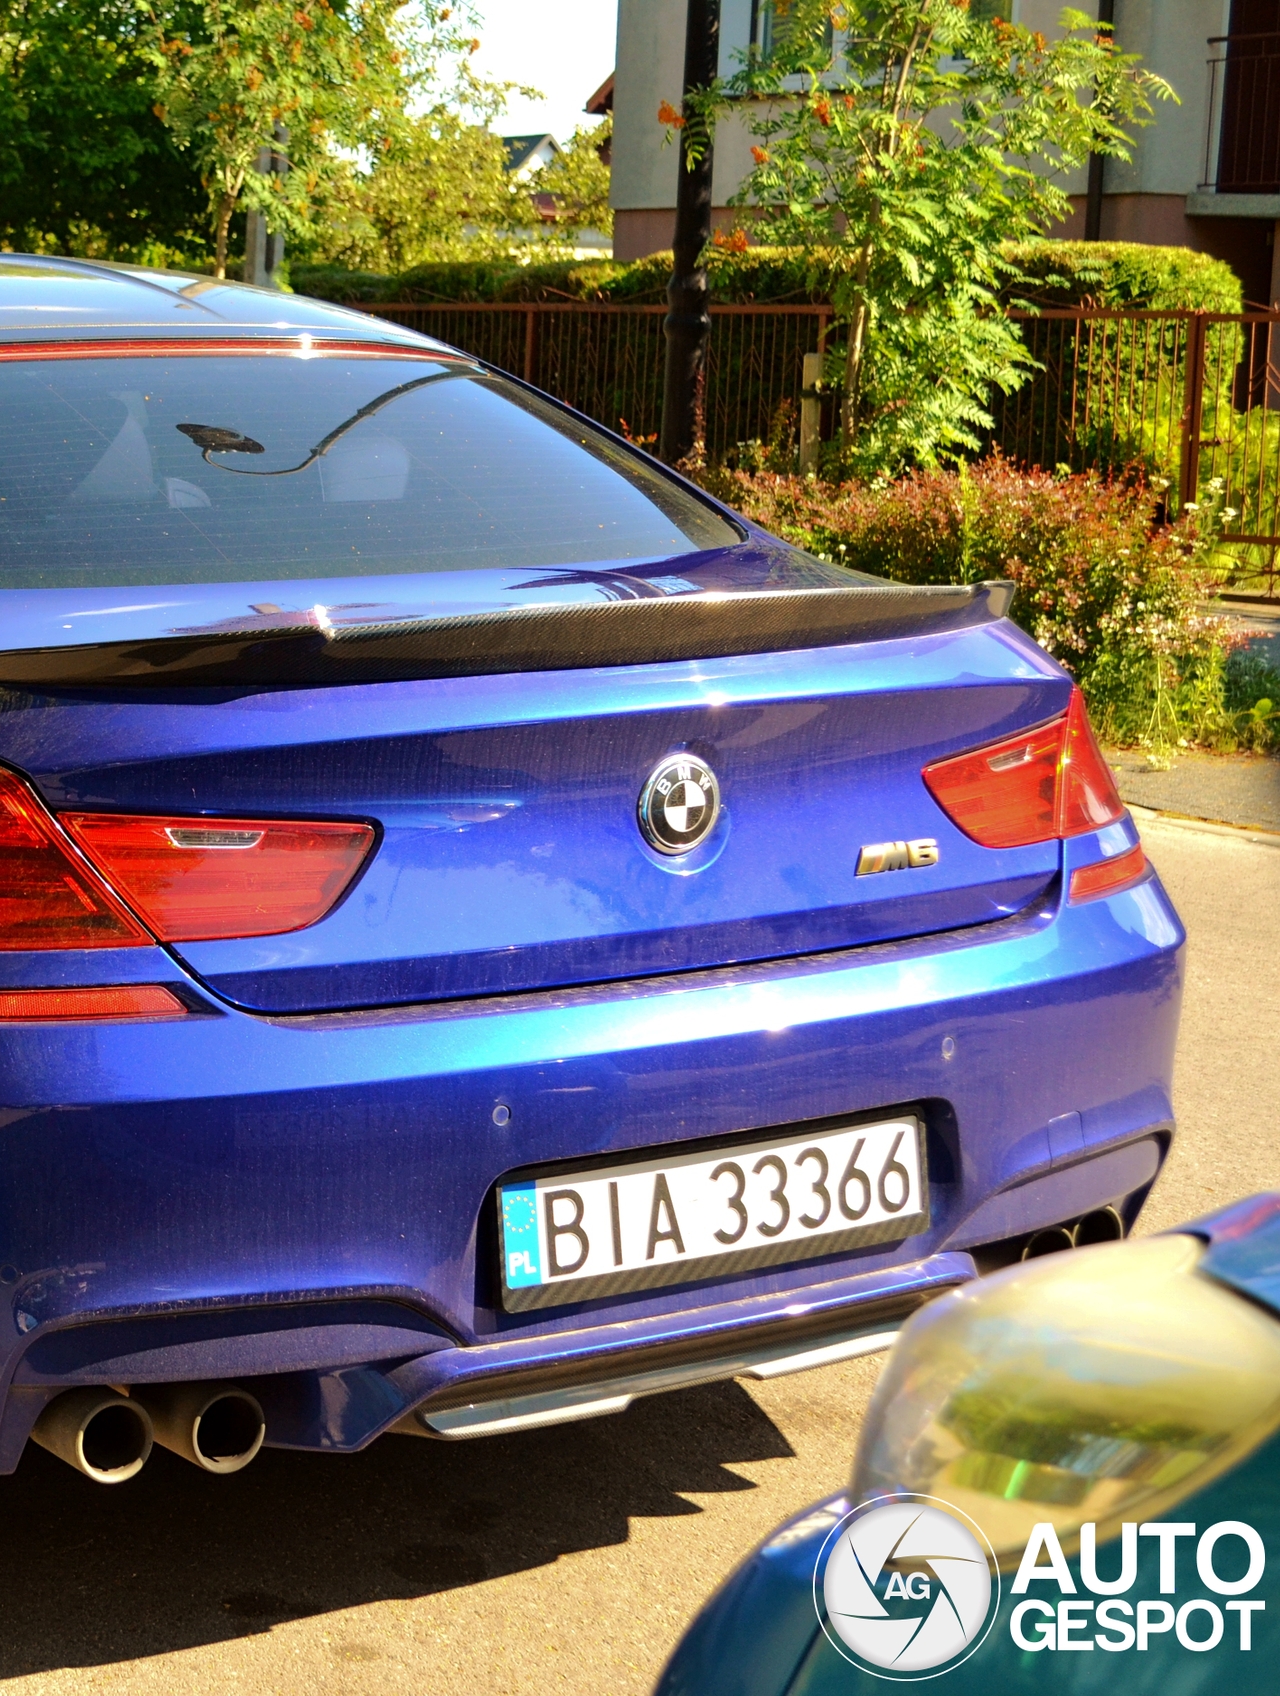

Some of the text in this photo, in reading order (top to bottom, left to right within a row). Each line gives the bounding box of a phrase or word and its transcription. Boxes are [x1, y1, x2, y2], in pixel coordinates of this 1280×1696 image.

[657, 766, 710, 794] BMW
[855, 838, 939, 876] M6
[543, 1131, 911, 1277] BIA 33366
[509, 1250, 536, 1277] PL
